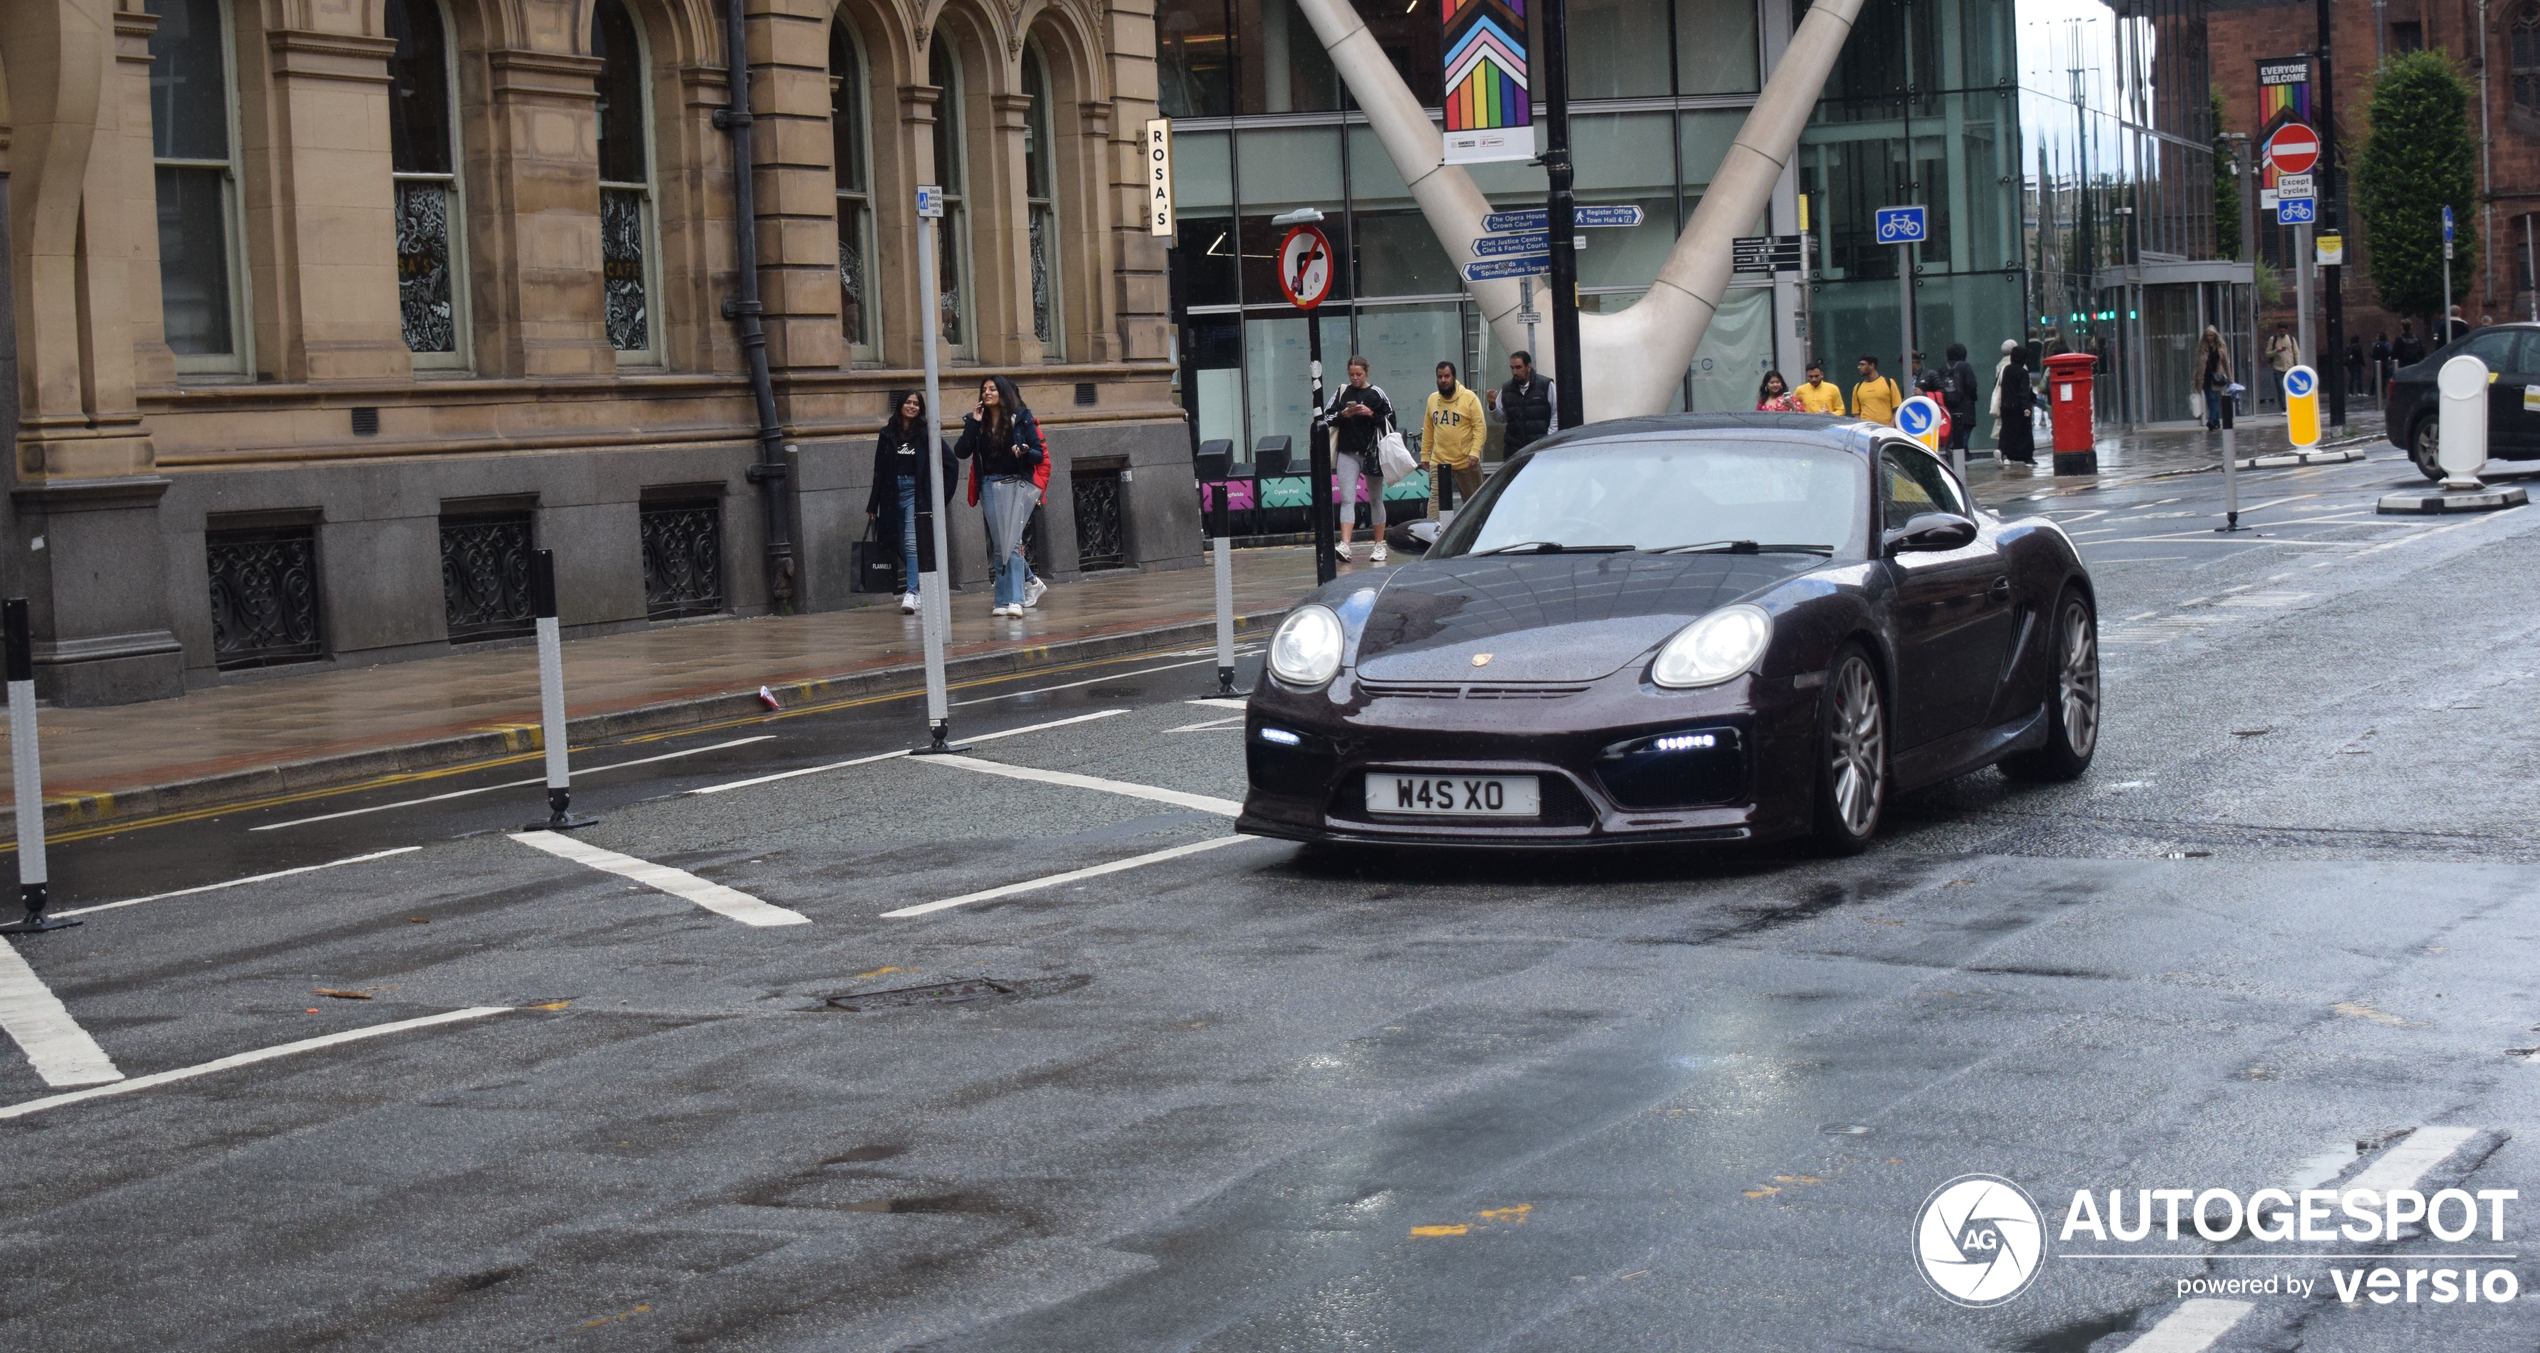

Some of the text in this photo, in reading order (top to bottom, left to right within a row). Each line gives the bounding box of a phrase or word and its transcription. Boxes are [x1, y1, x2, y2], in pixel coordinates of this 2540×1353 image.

[2261, 64, 2307, 76] EVERYONE
[2262, 73, 2306, 84] WELCOME
[1153, 130, 1168, 225] ROSA'S
[2281, 178, 2310, 186] Except
[2282, 187, 2308, 195] cycles
[1481, 266, 1525, 276] Spinningfields
[1433, 410, 1460, 426] GAP
[1397, 779, 1503, 810] W4S XO
